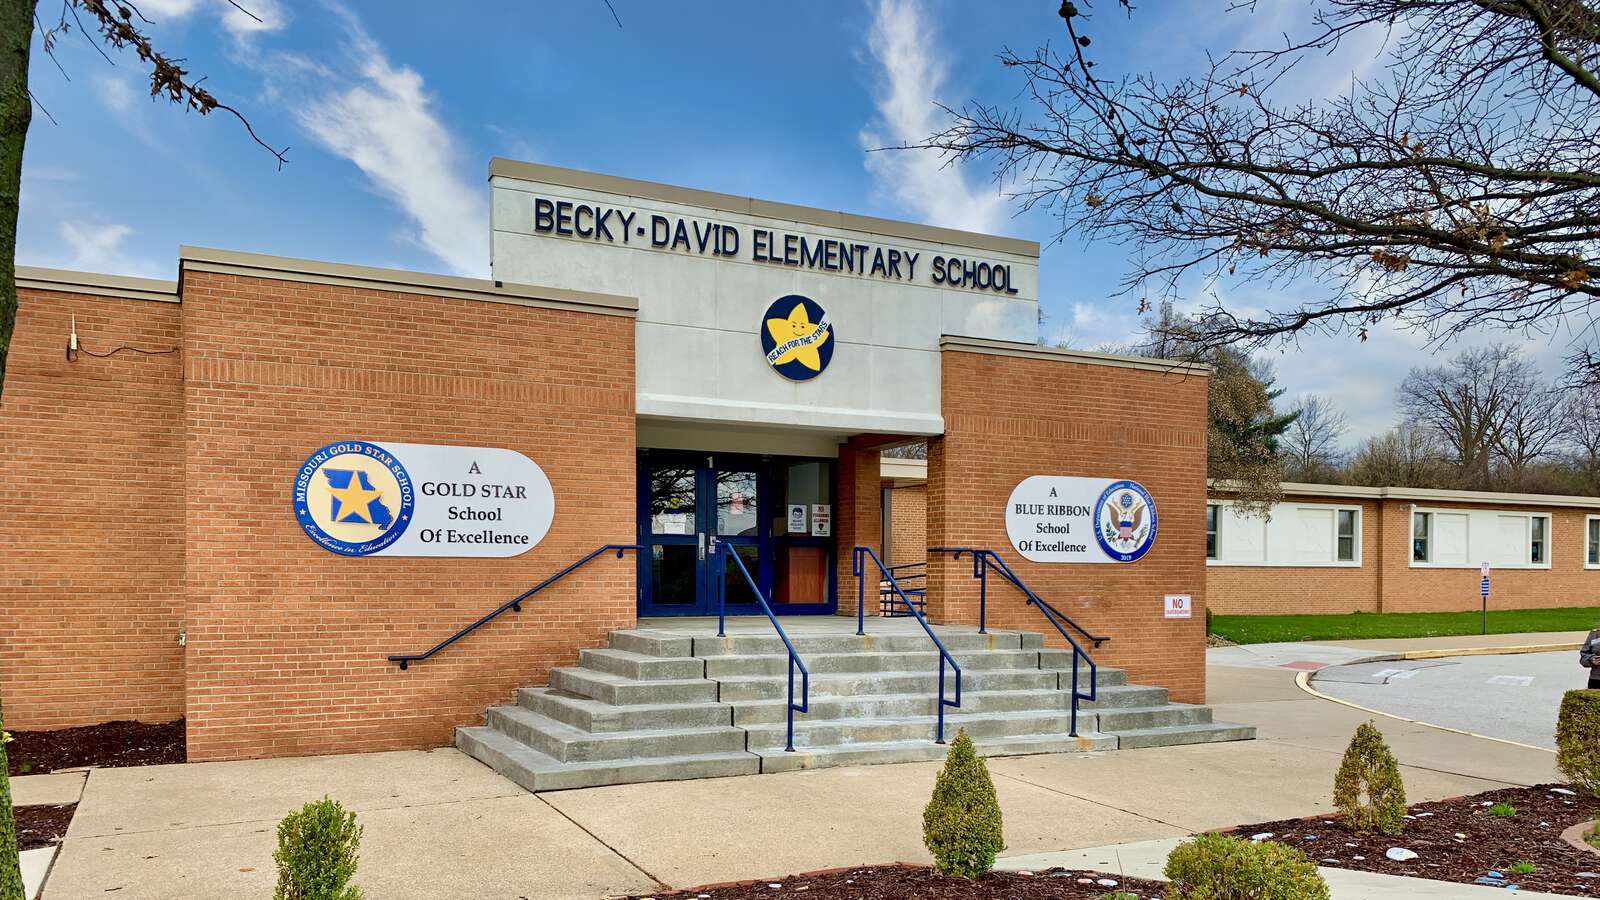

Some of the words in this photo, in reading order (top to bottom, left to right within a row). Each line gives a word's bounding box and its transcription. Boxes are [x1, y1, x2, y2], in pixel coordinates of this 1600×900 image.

[752, 229, 920, 281] ELEMENTARY
[931, 256, 1018, 294] SCHOOL
[768, 344, 789, 363] REACH
[788, 339, 800, 349] FOR
[800, 336, 813, 346] THE
[812, 320, 828, 341] STARS
[468, 461, 482, 475] A
[706, 456, 714, 469] 1
[296, 451, 329, 502] MISSOURI
[329, 444, 362, 456] GOLD
[364, 446, 393, 466] STAR
[391, 465, 412, 509] SCHOOL
[421, 482, 477, 499] GOLD
[481, 484, 528, 500] STAR
[1049, 487, 1058, 498] A
[448, 506, 503, 521] School
[1015, 503, 1045, 516] BLUE
[1047, 504, 1091, 517] RIBBON
[1036, 523, 1070, 534] School
[420, 528, 443, 544] Of
[447, 529, 529, 545] Excellence
[1018, 540, 1033, 552] Of
[1035, 541, 1087, 553] Excellence
[1172, 598, 1184, 609] NO
